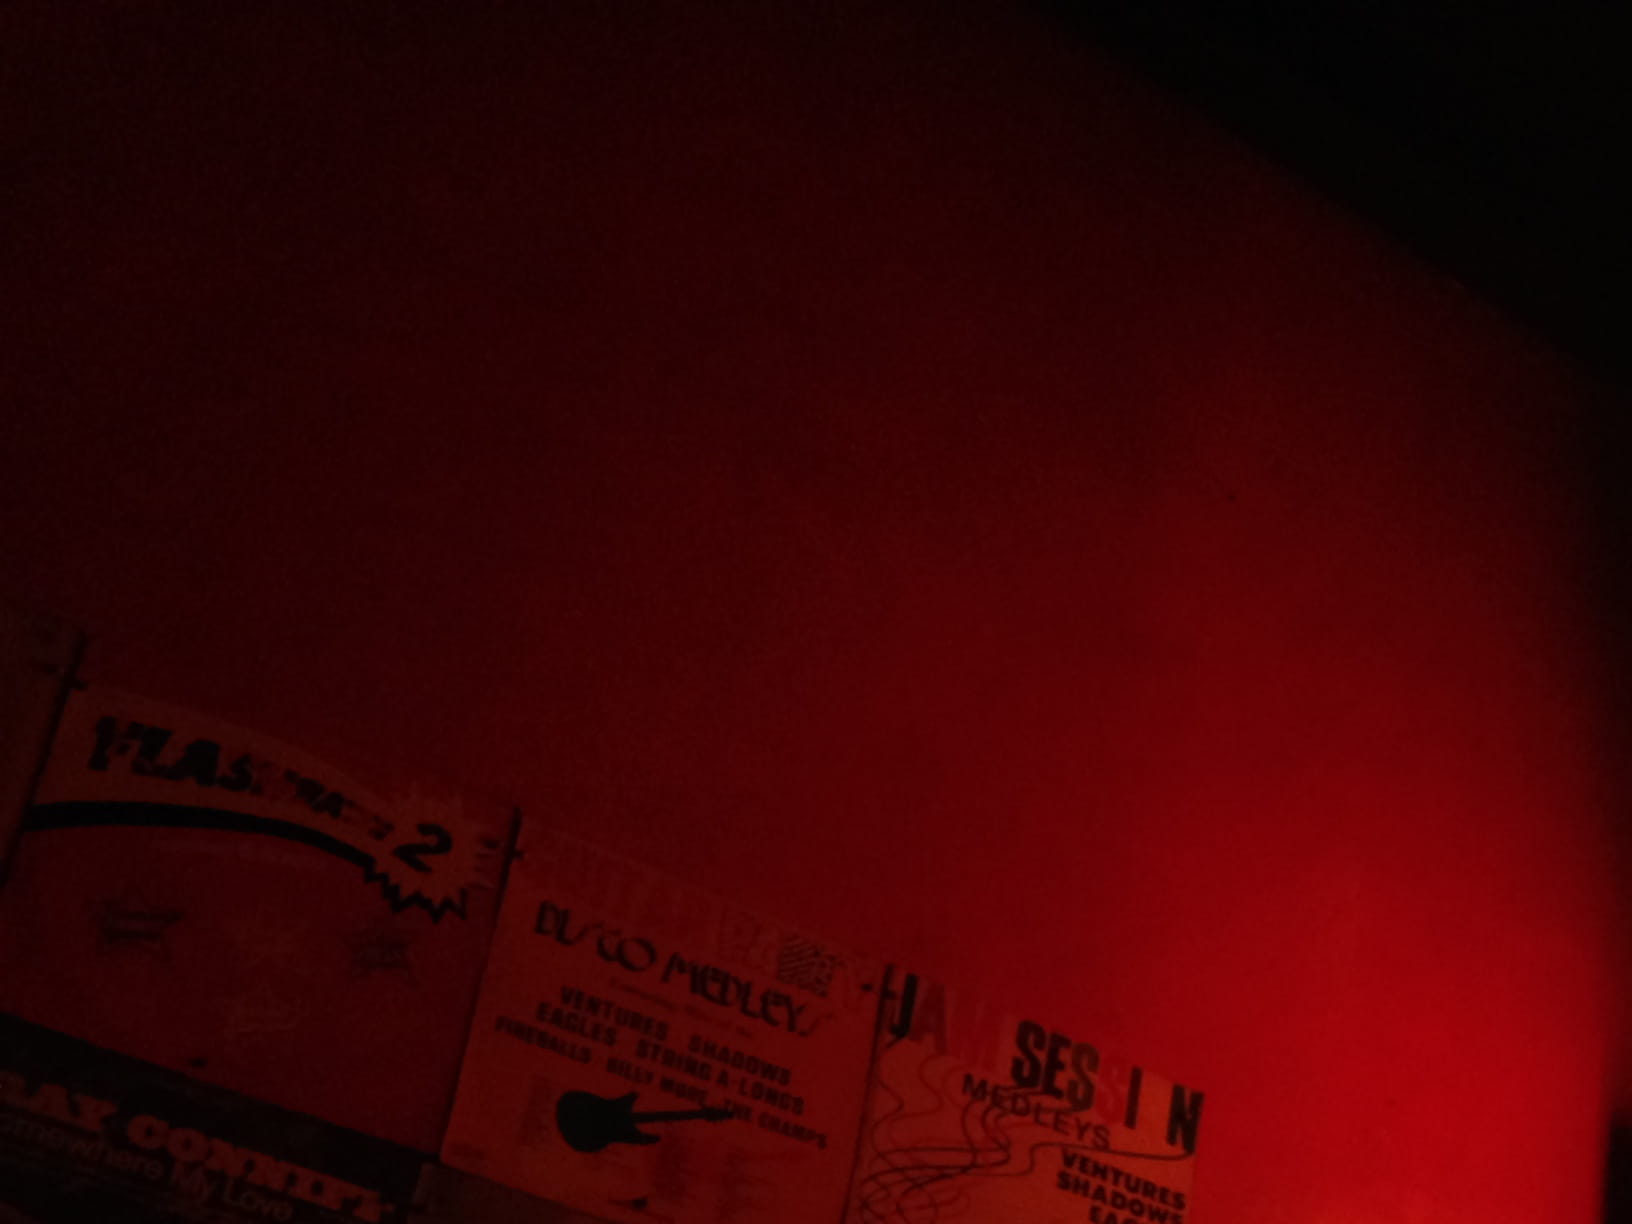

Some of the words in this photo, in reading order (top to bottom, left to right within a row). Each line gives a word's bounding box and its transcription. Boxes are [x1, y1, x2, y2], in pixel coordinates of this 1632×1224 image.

[392, 822, 454, 874] 2
[659, 952, 822, 1037] MEDLEY
[496, 1015, 592, 1065] FIREBALLS
[535, 1001, 618, 1047] EAGLES
[636, 1038, 714, 1081] STRING
[561, 984, 670, 1041] VENTURES
[688, 1033, 792, 1087] SHADOWS
[960, 1073, 1111, 1151] MEDLEYS
[223, 1176, 295, 1222] Love
[1060, 1148, 1188, 1211] VENTURES
